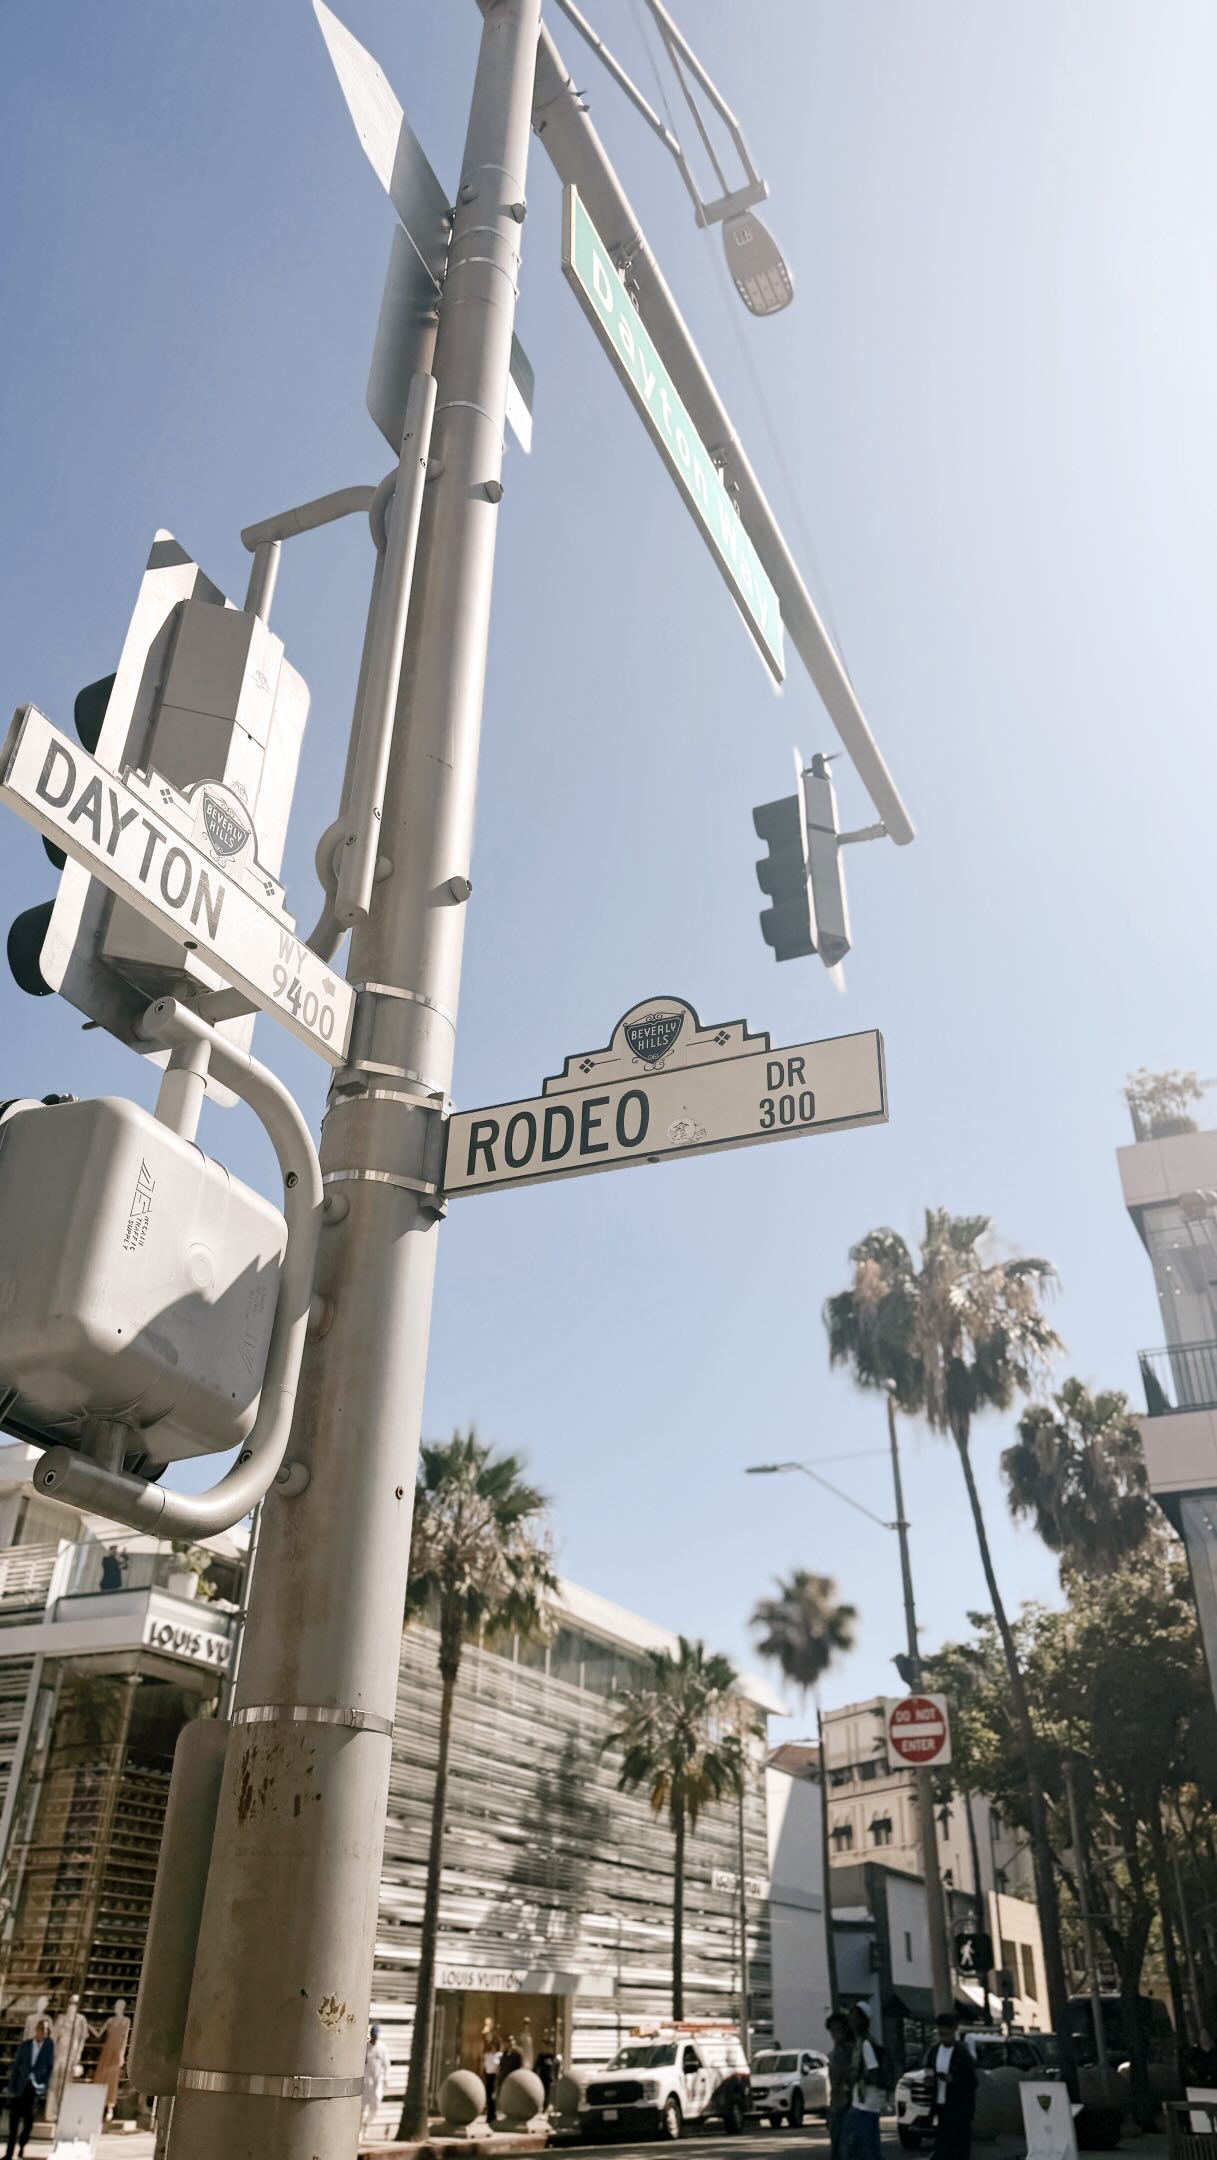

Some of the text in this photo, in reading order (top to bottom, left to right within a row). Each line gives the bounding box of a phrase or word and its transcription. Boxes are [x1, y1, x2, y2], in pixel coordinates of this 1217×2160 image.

[592, 248, 768, 628] Dayton Way
[35, 738, 226, 941] DAYTON
[207, 804, 242, 841] BEVERLY
[210, 820, 235, 848] HILLS
[279, 930, 308, 974] WY
[272, 964, 335, 1041] 9400
[631, 1022, 676, 1040] BEVERLY
[638, 1035, 669, 1050] HILLS
[766, 1056, 806, 1091] DR
[759, 1091, 816, 1130] 300
[466, 1089, 650, 1177] RODEO
[122, 1219, 134, 1251] SUPPLY
[129, 1217, 142, 1252] TRAFFIC
[150, 1622, 202, 1655] LOUIS
[896, 1707, 937, 1723] DO NOT
[902, 1738, 936, 1752] ENTER
[442, 1970, 523, 1989] LOUIS VUITTON
